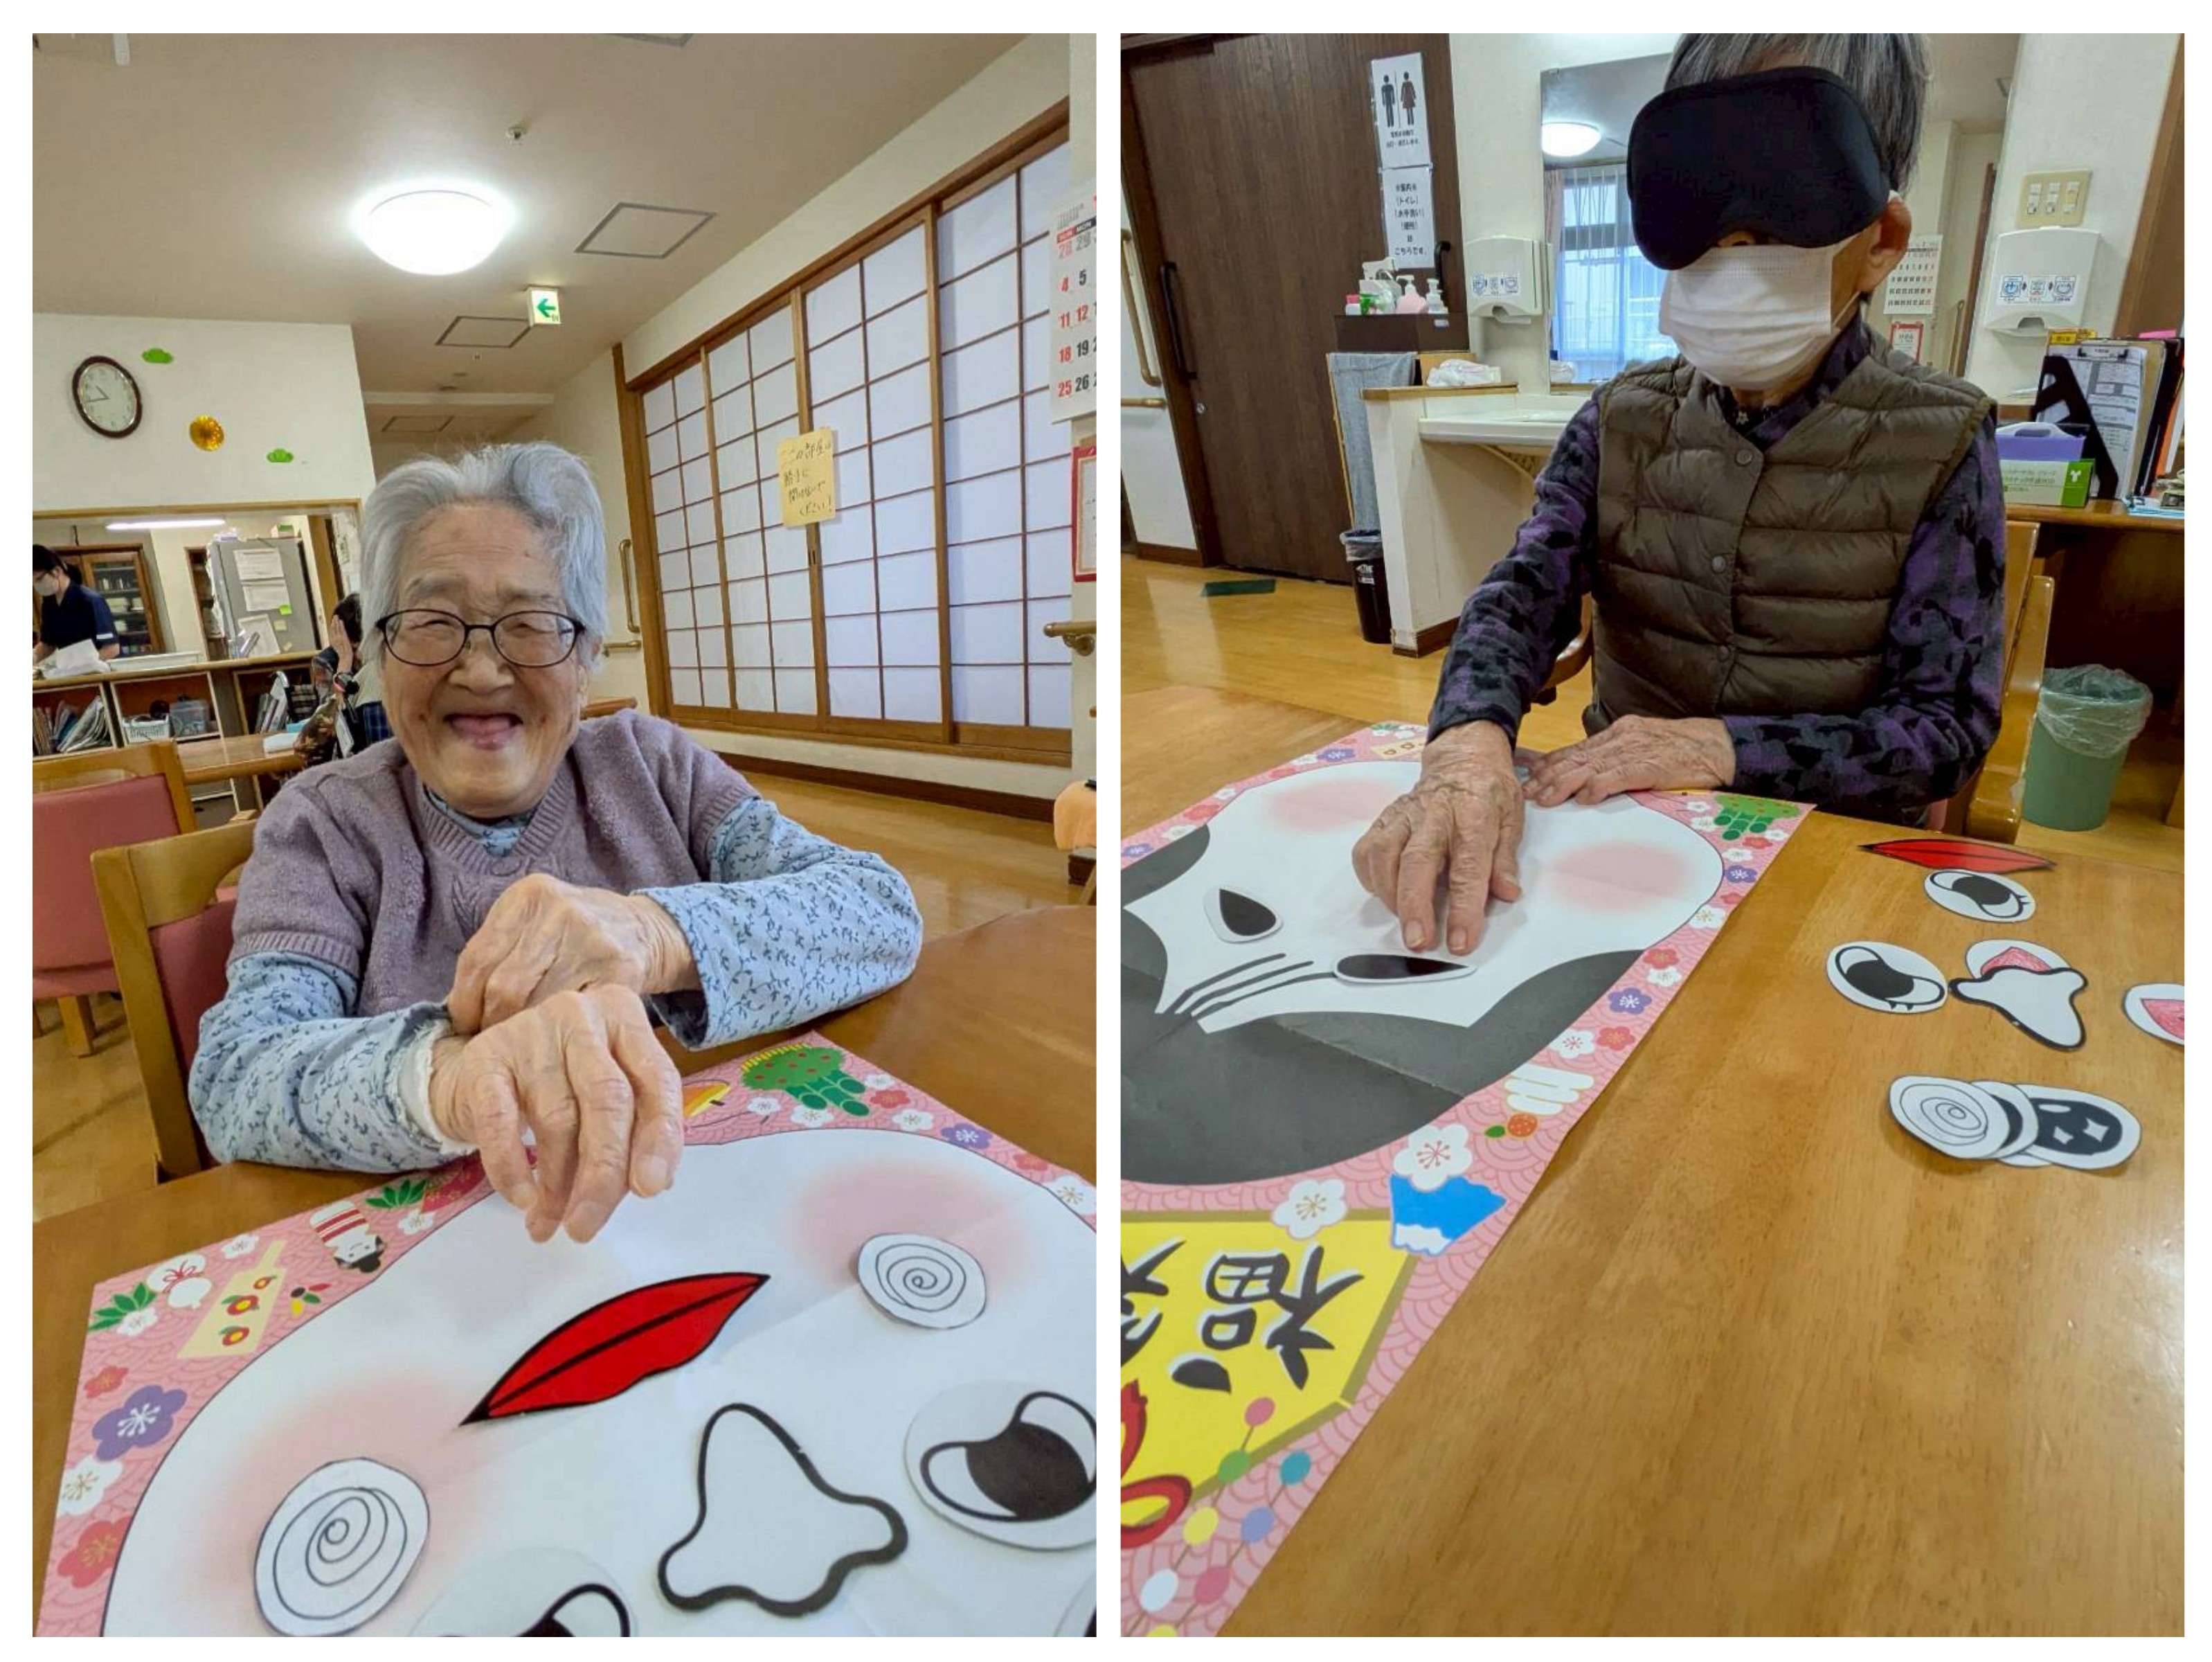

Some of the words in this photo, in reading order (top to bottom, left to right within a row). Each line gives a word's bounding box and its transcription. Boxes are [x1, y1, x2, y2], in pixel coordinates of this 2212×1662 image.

[1061, 276, 1069, 292] 4
[1079, 269, 1087, 286] 5
[1060, 312, 1070, 329] 11
[1076, 304, 1089, 322] 12
[1059, 346, 1072, 363] 18
[1077, 339, 1089, 357] 19
[1058, 380, 1072, 397] 25
[1075, 374, 1089, 393] 26
